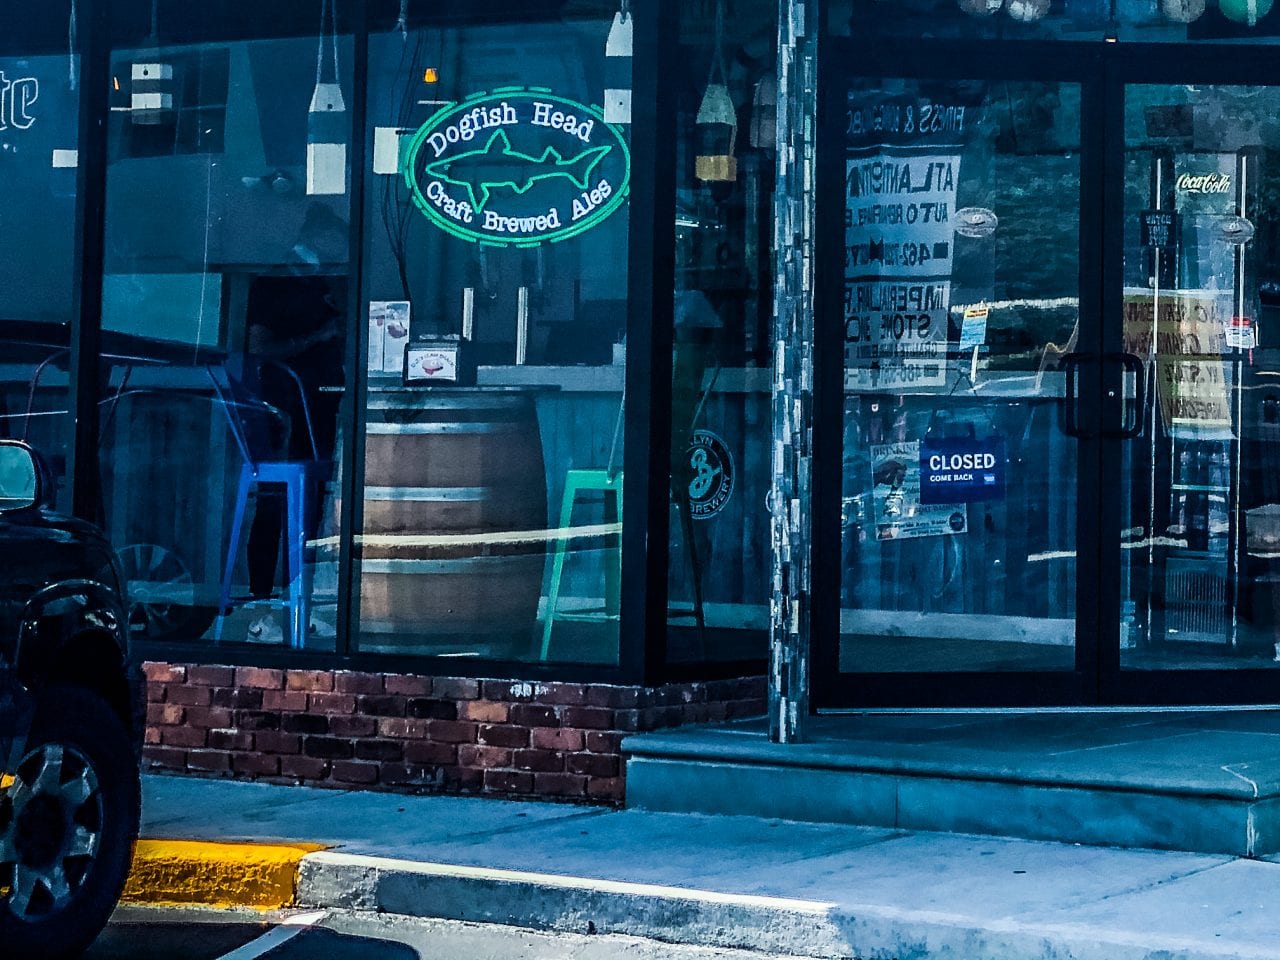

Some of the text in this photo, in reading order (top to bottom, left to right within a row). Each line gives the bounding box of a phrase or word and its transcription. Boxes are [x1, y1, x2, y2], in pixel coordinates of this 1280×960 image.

[427, 102, 594, 157] Dogfish Head
[427, 179, 612, 233] Craft Brewed Ales
[929, 453, 996, 470] CLOSED
[929, 474, 951, 482] COME
[953, 473, 974, 482] BACK
